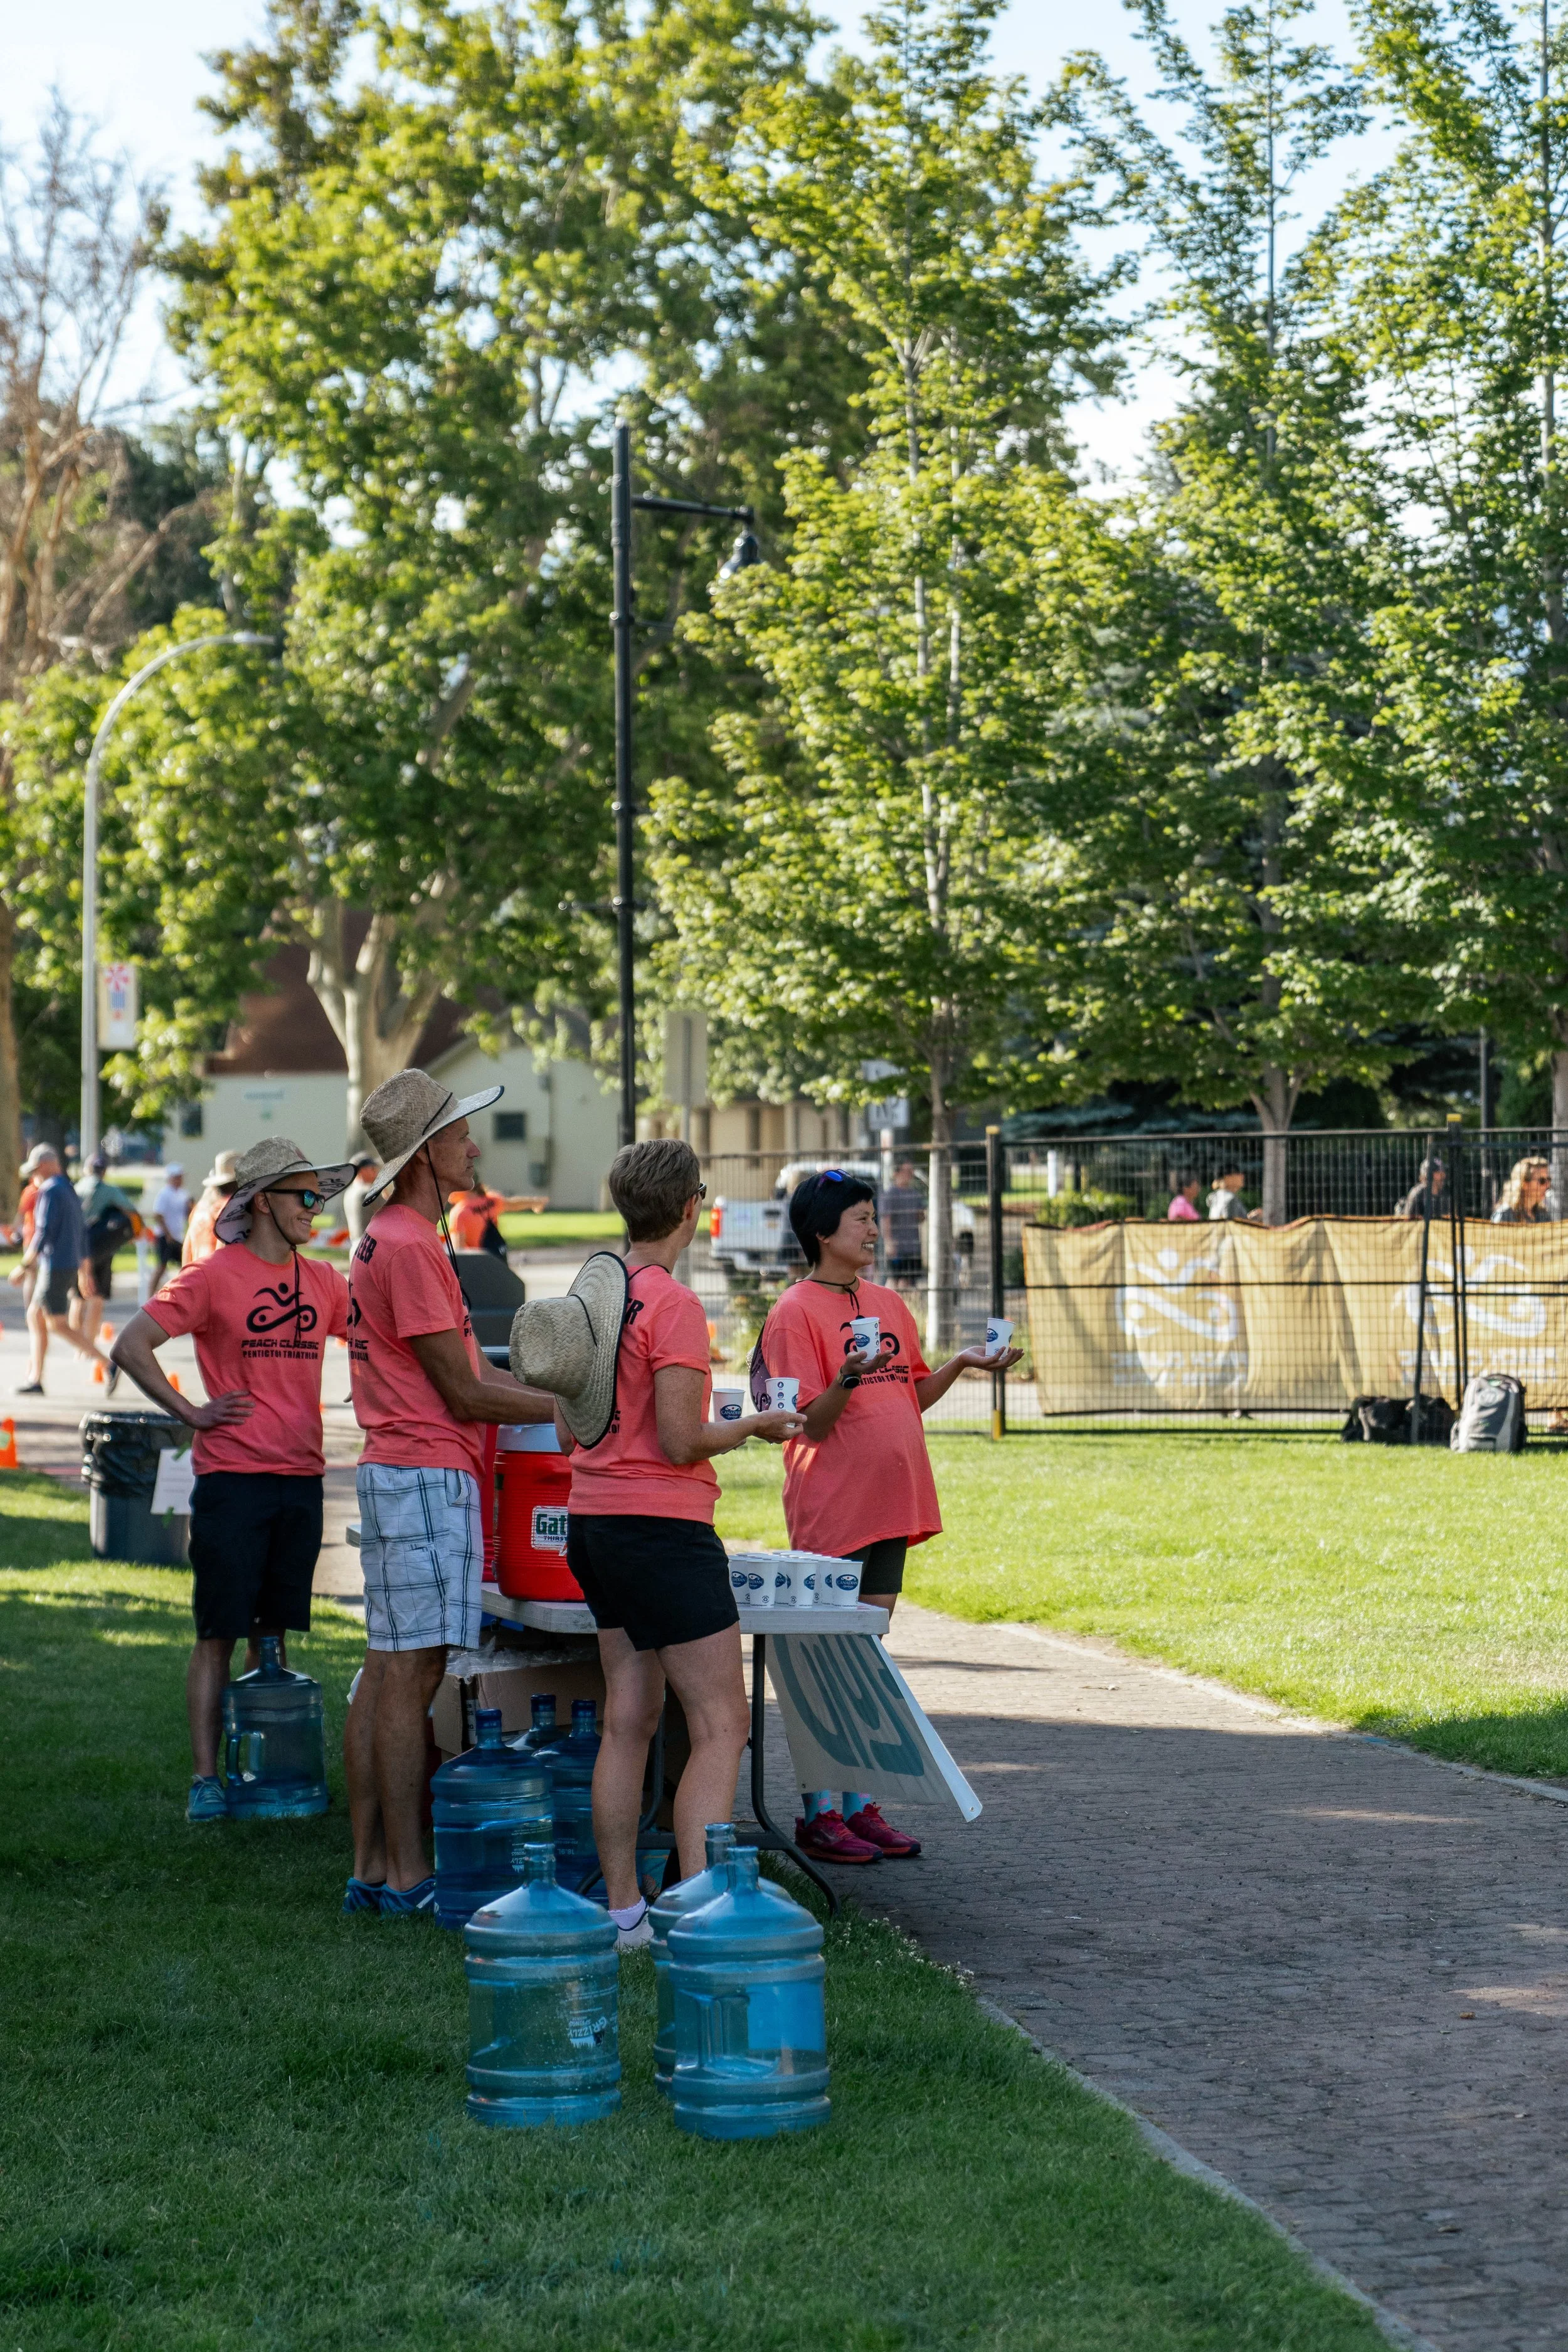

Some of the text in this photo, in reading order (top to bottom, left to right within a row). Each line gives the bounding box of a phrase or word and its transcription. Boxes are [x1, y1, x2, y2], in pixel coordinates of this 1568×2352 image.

[241, 1338, 319, 1350] PEACH CLASSIC
[243, 1349, 319, 1360] PENTICTON TRIATHLON
[567, 2015, 608, 2038] GRIZZLY
